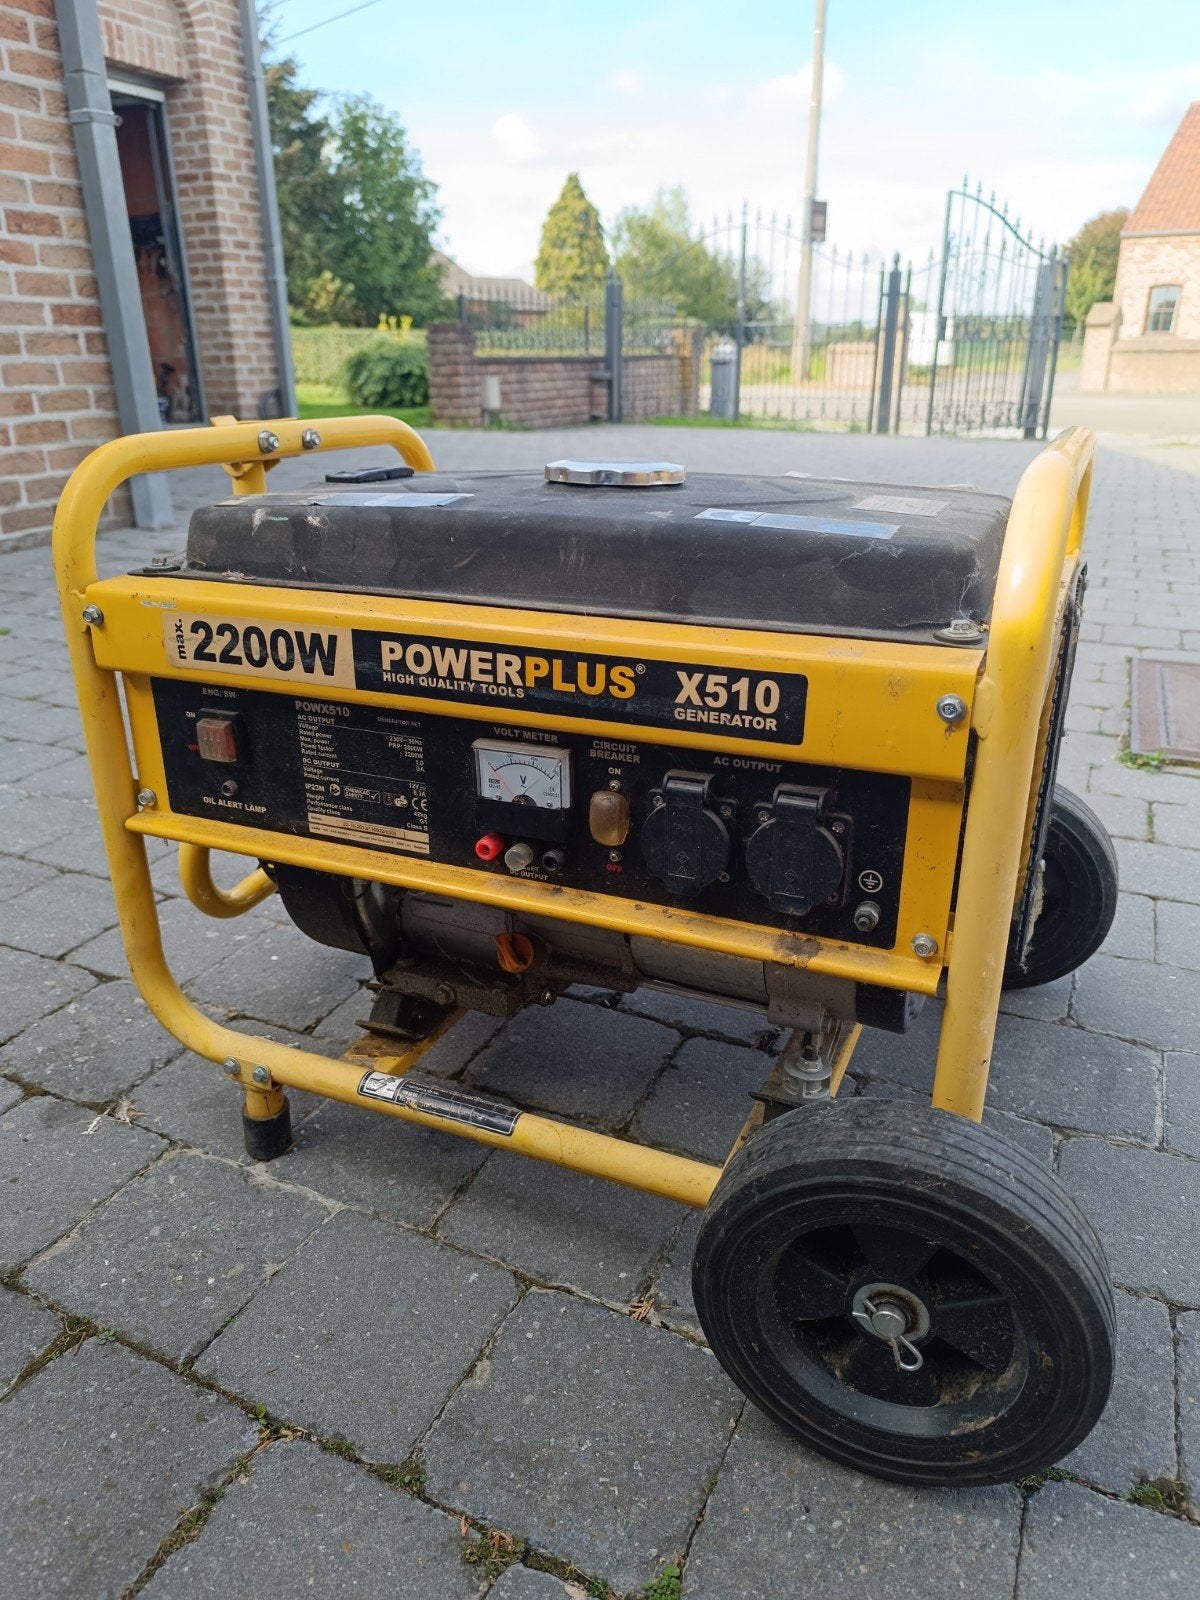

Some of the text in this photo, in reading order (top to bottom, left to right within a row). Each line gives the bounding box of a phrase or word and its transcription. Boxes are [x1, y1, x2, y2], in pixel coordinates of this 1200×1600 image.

[174, 618, 338, 677] max. 2200W
[382, 671, 525, 699] HIGH QUALITY TOOLS
[674, 670, 780, 715] X510
[202, 687, 236, 699] ENG. SW
[295, 700, 350, 717] POWX510
[308, 716, 335, 725] OUTPUT
[674, 707, 778, 732] GENERATOR
[493, 726, 558, 744] VOLT METER
[592, 740, 637, 753] CIRCUIT
[302, 757, 340, 769] DC OUTPUT
[589, 749, 641, 764] BREAKER
[608, 767, 621, 775] ON
[713, 757, 782, 773] AC OUTPUT
[519, 775, 527, 785] V
[202, 796, 267, 814] OIL ALERT LAMP
[411, 797, 428, 812] CE
[520, 871, 549, 881] OUTPUT
